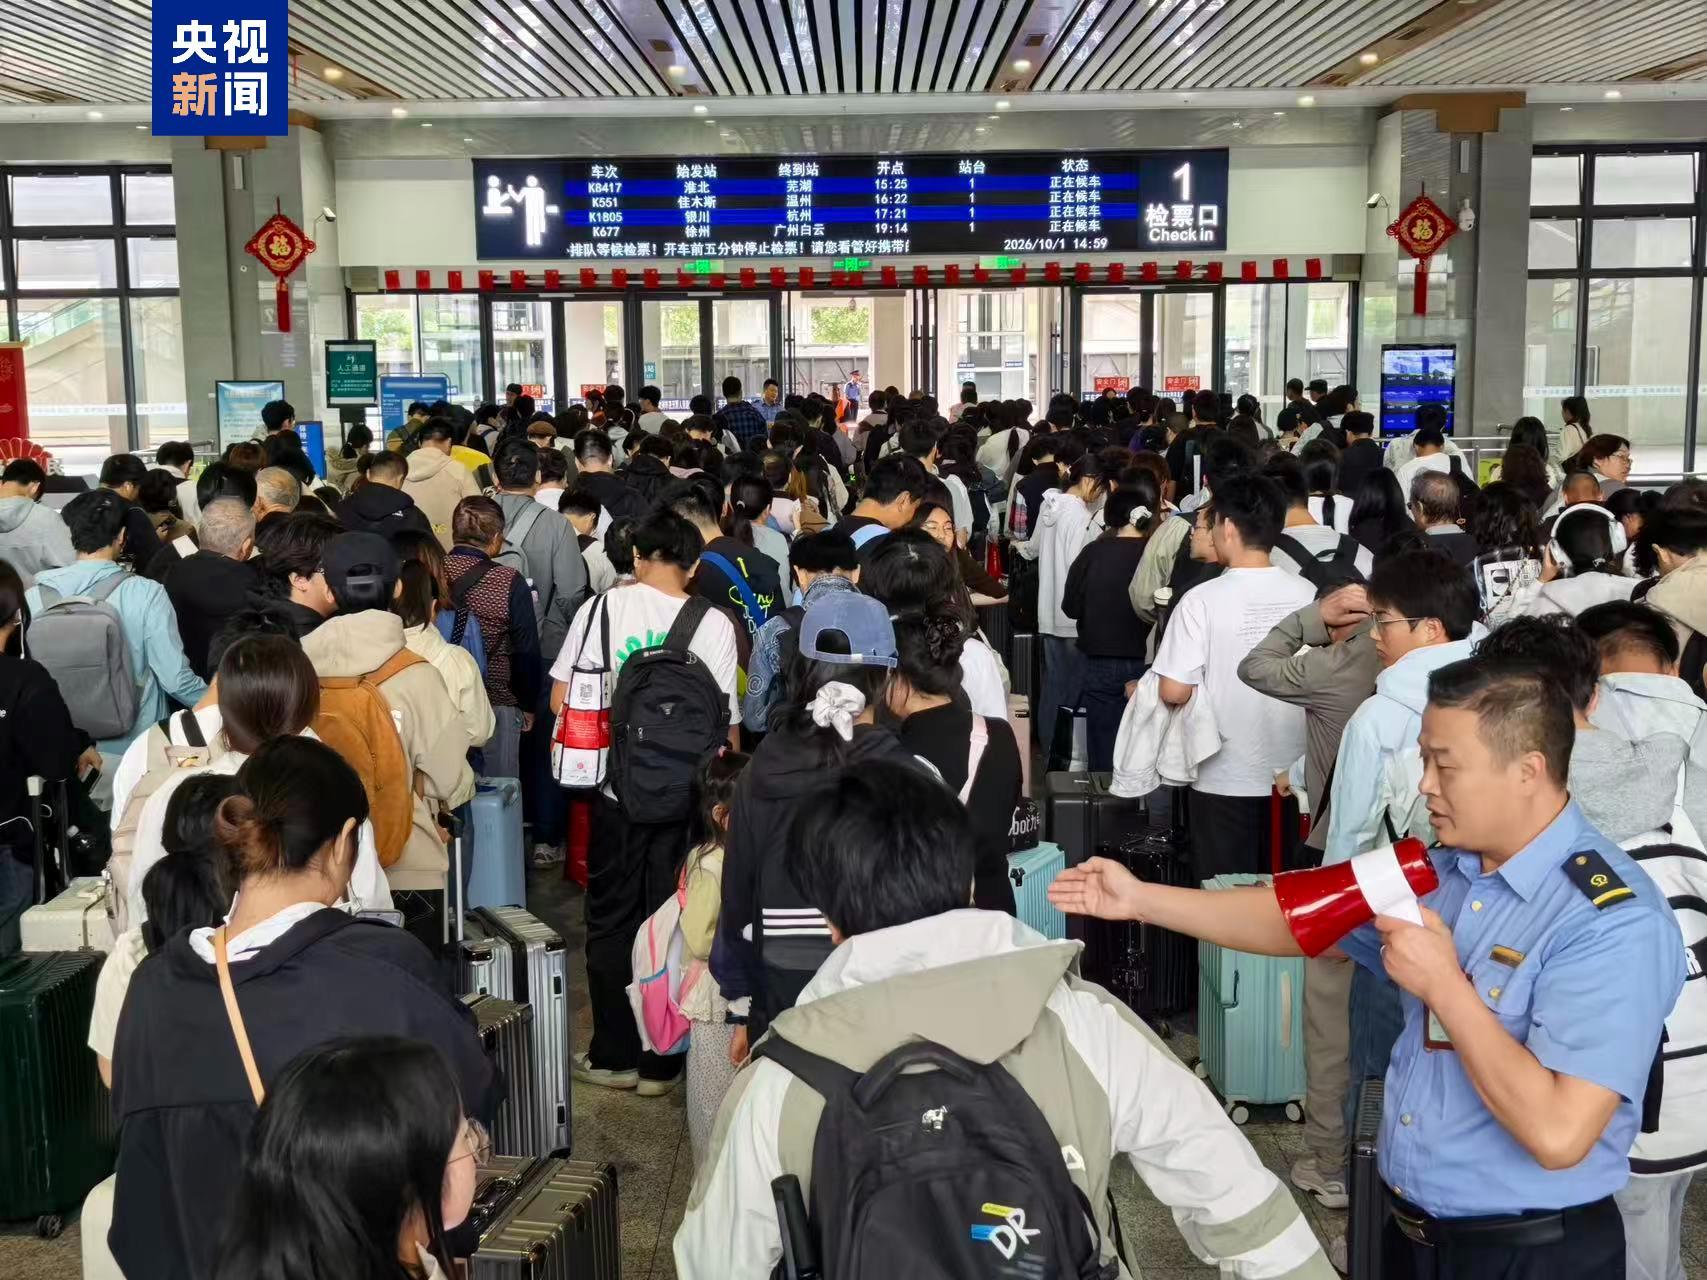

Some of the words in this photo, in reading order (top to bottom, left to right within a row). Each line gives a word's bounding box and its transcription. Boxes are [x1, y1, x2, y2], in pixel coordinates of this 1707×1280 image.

[591, 164, 619, 180] 车次
[676, 163, 717, 179] 始发站
[777, 161, 820, 177] 终到站
[876, 160, 905, 176] 开点
[958, 159, 986, 175] 站台
[1061, 157, 1089, 173] 状态
[588, 181, 623, 194] K8417
[684, 180, 711, 195] 淮北
[786, 179, 813, 193] 芜湖
[874, 178, 908, 190] 15:25
[968, 178, 975, 189] 1
[1049, 175, 1102, 189] 正在候车
[1171, 161, 1191, 202] 1
[591, 196, 619, 208] K551
[676, 195, 717, 209] 佳木斯
[786, 193, 812, 208] 温州
[874, 193, 908, 205] 16:22
[968, 193, 975, 204] 1
[1049, 190, 1102, 204] 正在候车
[588, 211, 623, 223] K1805
[685, 210, 711, 224] 银川
[786, 208, 812, 223] 杭州
[874, 207, 907, 219] 17:21
[968, 207, 975, 218] 1
[1049, 205, 1101, 219] 正在候车
[1145, 203, 1219, 227] 检票口
[592, 226, 621, 238] K677
[685, 225, 711, 239] 徐州
[773, 223, 825, 238] 广州白云
[875, 222, 909, 234] 19:14
[968, 222, 975, 232] 1
[1049, 219, 1101, 233] 正在候车
[1148, 227, 1197, 243] Check
[1199, 227, 1216, 241] in
[1410, 218, 1434, 240] 福
[268, 234, 292, 256] 福
[1003, 238, 1066, 251] 2026/10/1
[1072, 237, 1109, 250] 14:59
